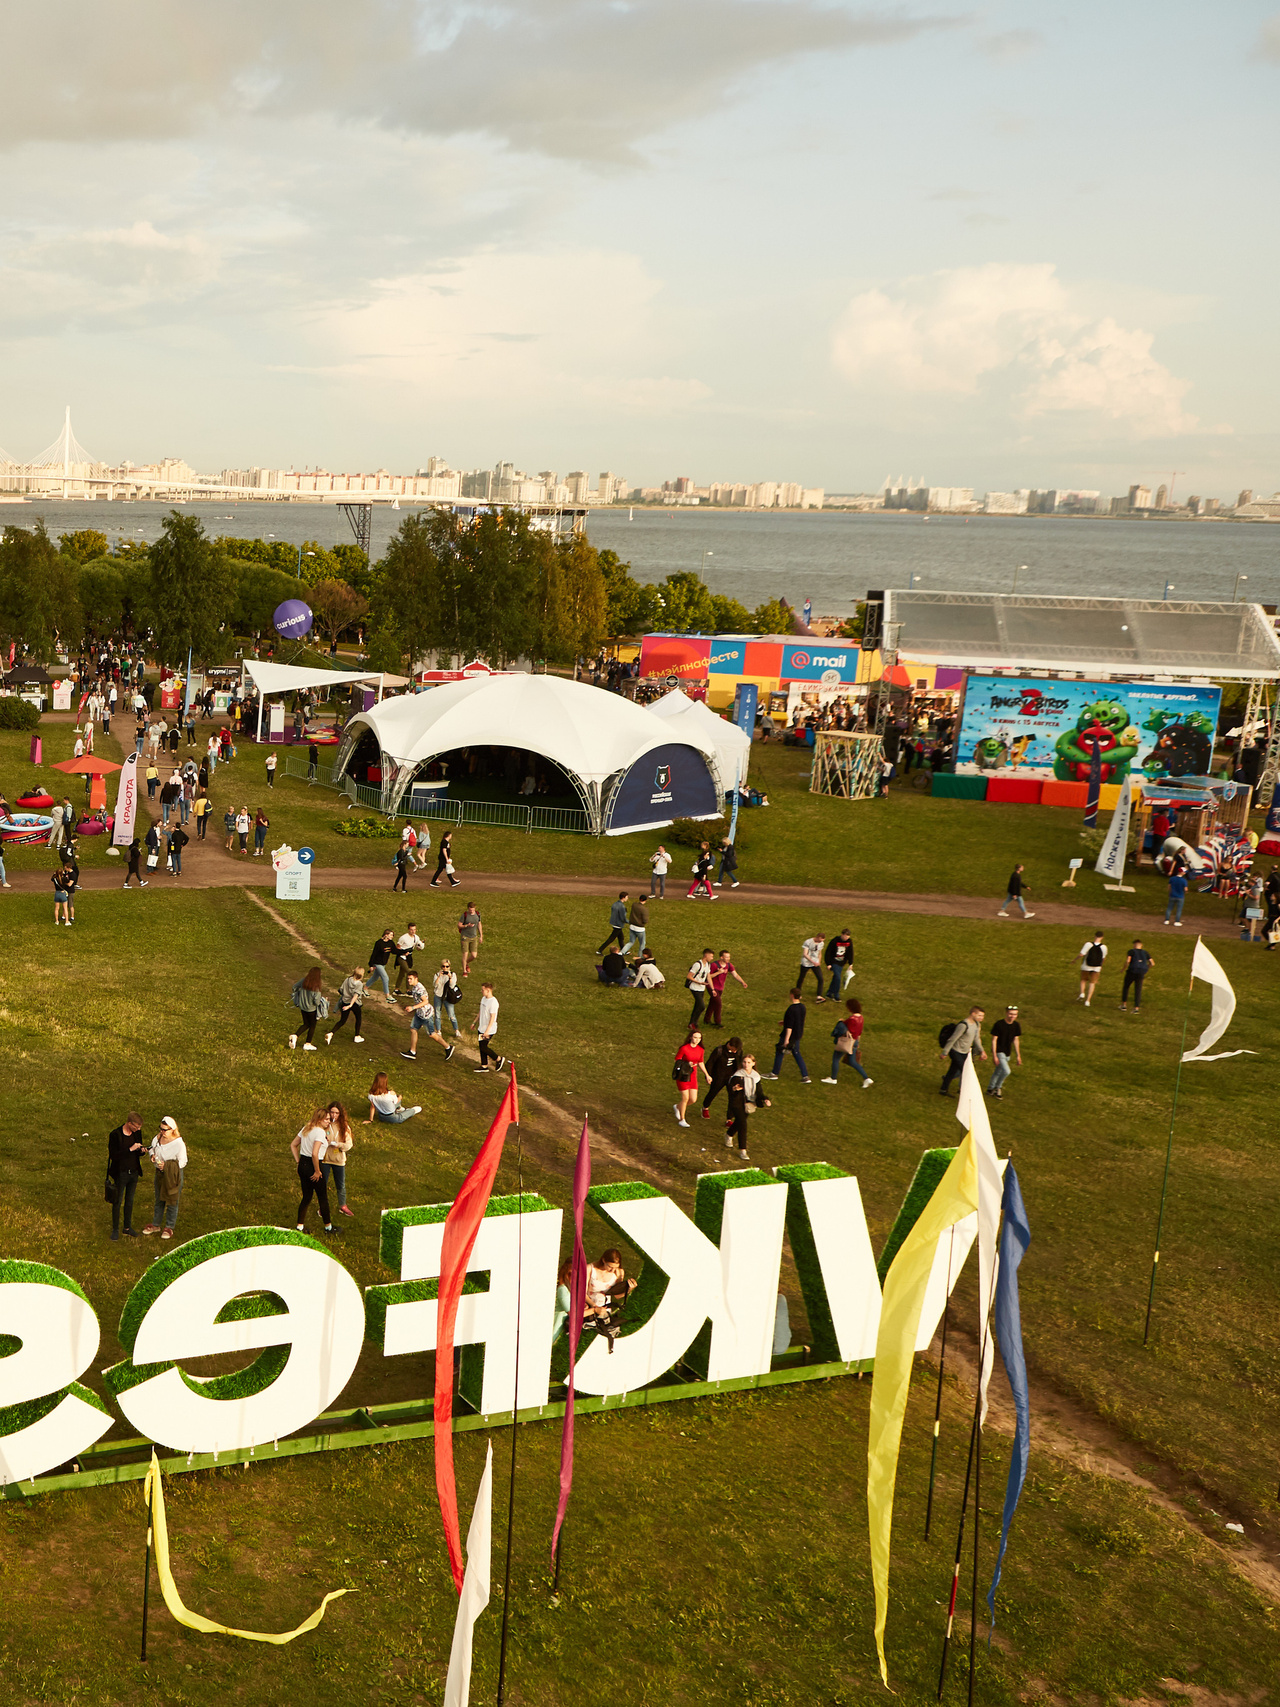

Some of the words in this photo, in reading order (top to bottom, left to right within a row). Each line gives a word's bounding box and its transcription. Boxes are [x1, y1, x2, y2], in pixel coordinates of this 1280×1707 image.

[276, 613, 307, 630] curious
[812, 655, 847, 668] mail
[990, 695, 1029, 709] ANGRY
[1032, 697, 1070, 710] BIRDS
[123, 778, 134, 825] КРАСОТА
[1104, 832, 1122, 871] HOCKEY
